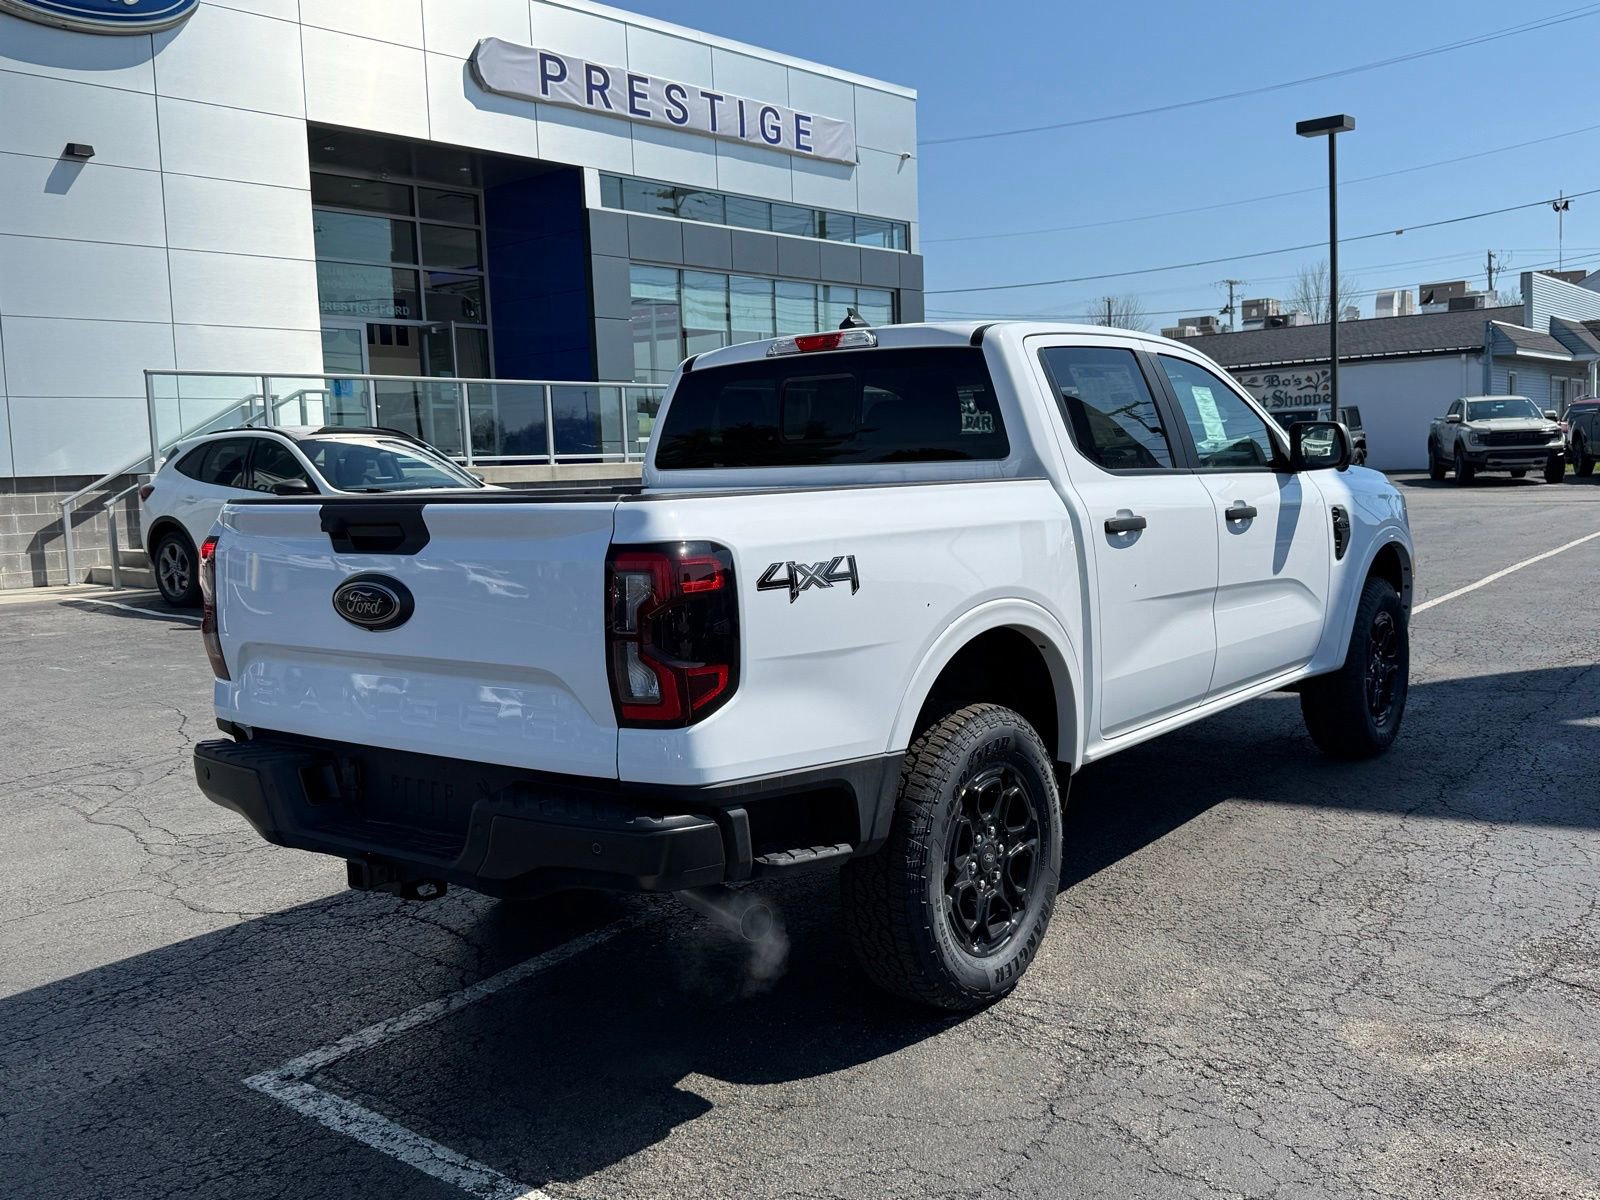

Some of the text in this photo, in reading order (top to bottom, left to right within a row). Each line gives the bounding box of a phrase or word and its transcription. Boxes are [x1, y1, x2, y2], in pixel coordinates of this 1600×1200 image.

[538, 52, 814, 153] PRESTIGE
[380, 305, 411, 316] FORD
[1263, 374, 1302, 389] Bo's
[1271, 389, 1331, 409] Shoppe
[347, 590, 383, 614] Ford
